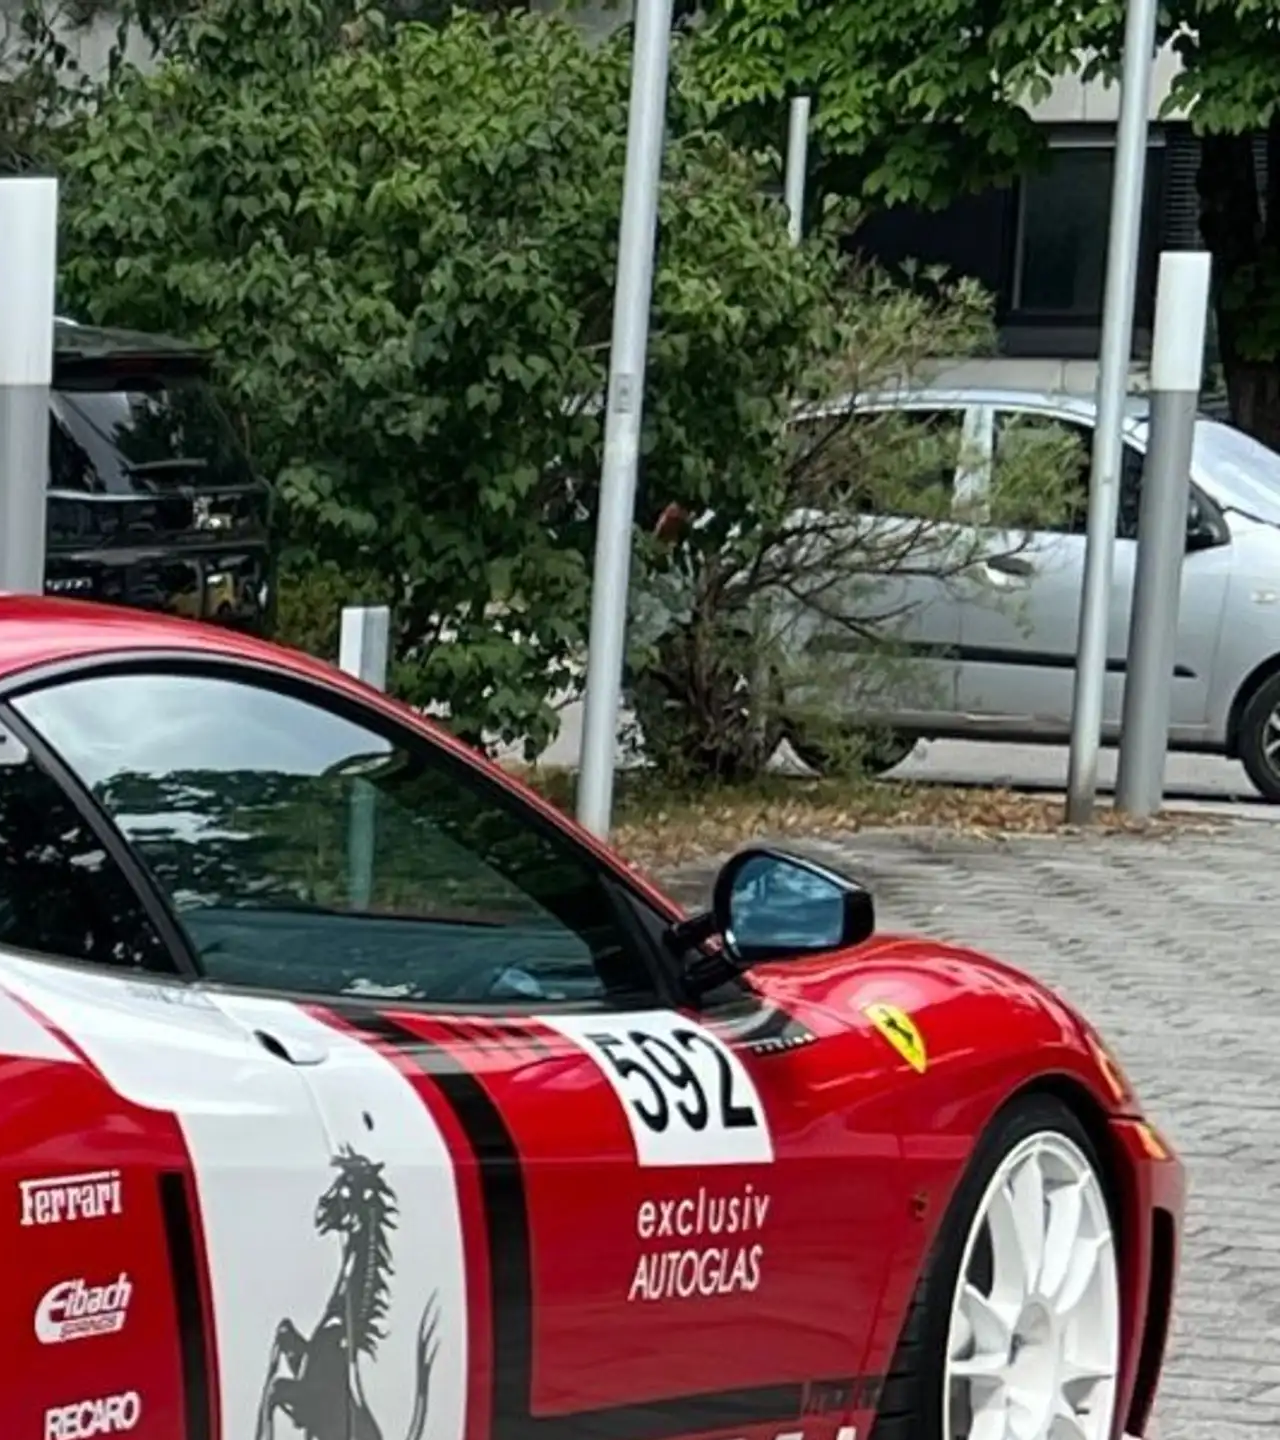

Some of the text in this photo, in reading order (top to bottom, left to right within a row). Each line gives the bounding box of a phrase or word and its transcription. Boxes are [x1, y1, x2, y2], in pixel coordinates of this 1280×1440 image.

[583, 1029, 758, 1132] 592
[19, 1169, 122, 1226] Ferrari
[637, 1184, 771, 1238] exclusiv
[627, 1245, 763, 1301] AUTOGLAS
[34, 1271, 133, 1344] Eibach
